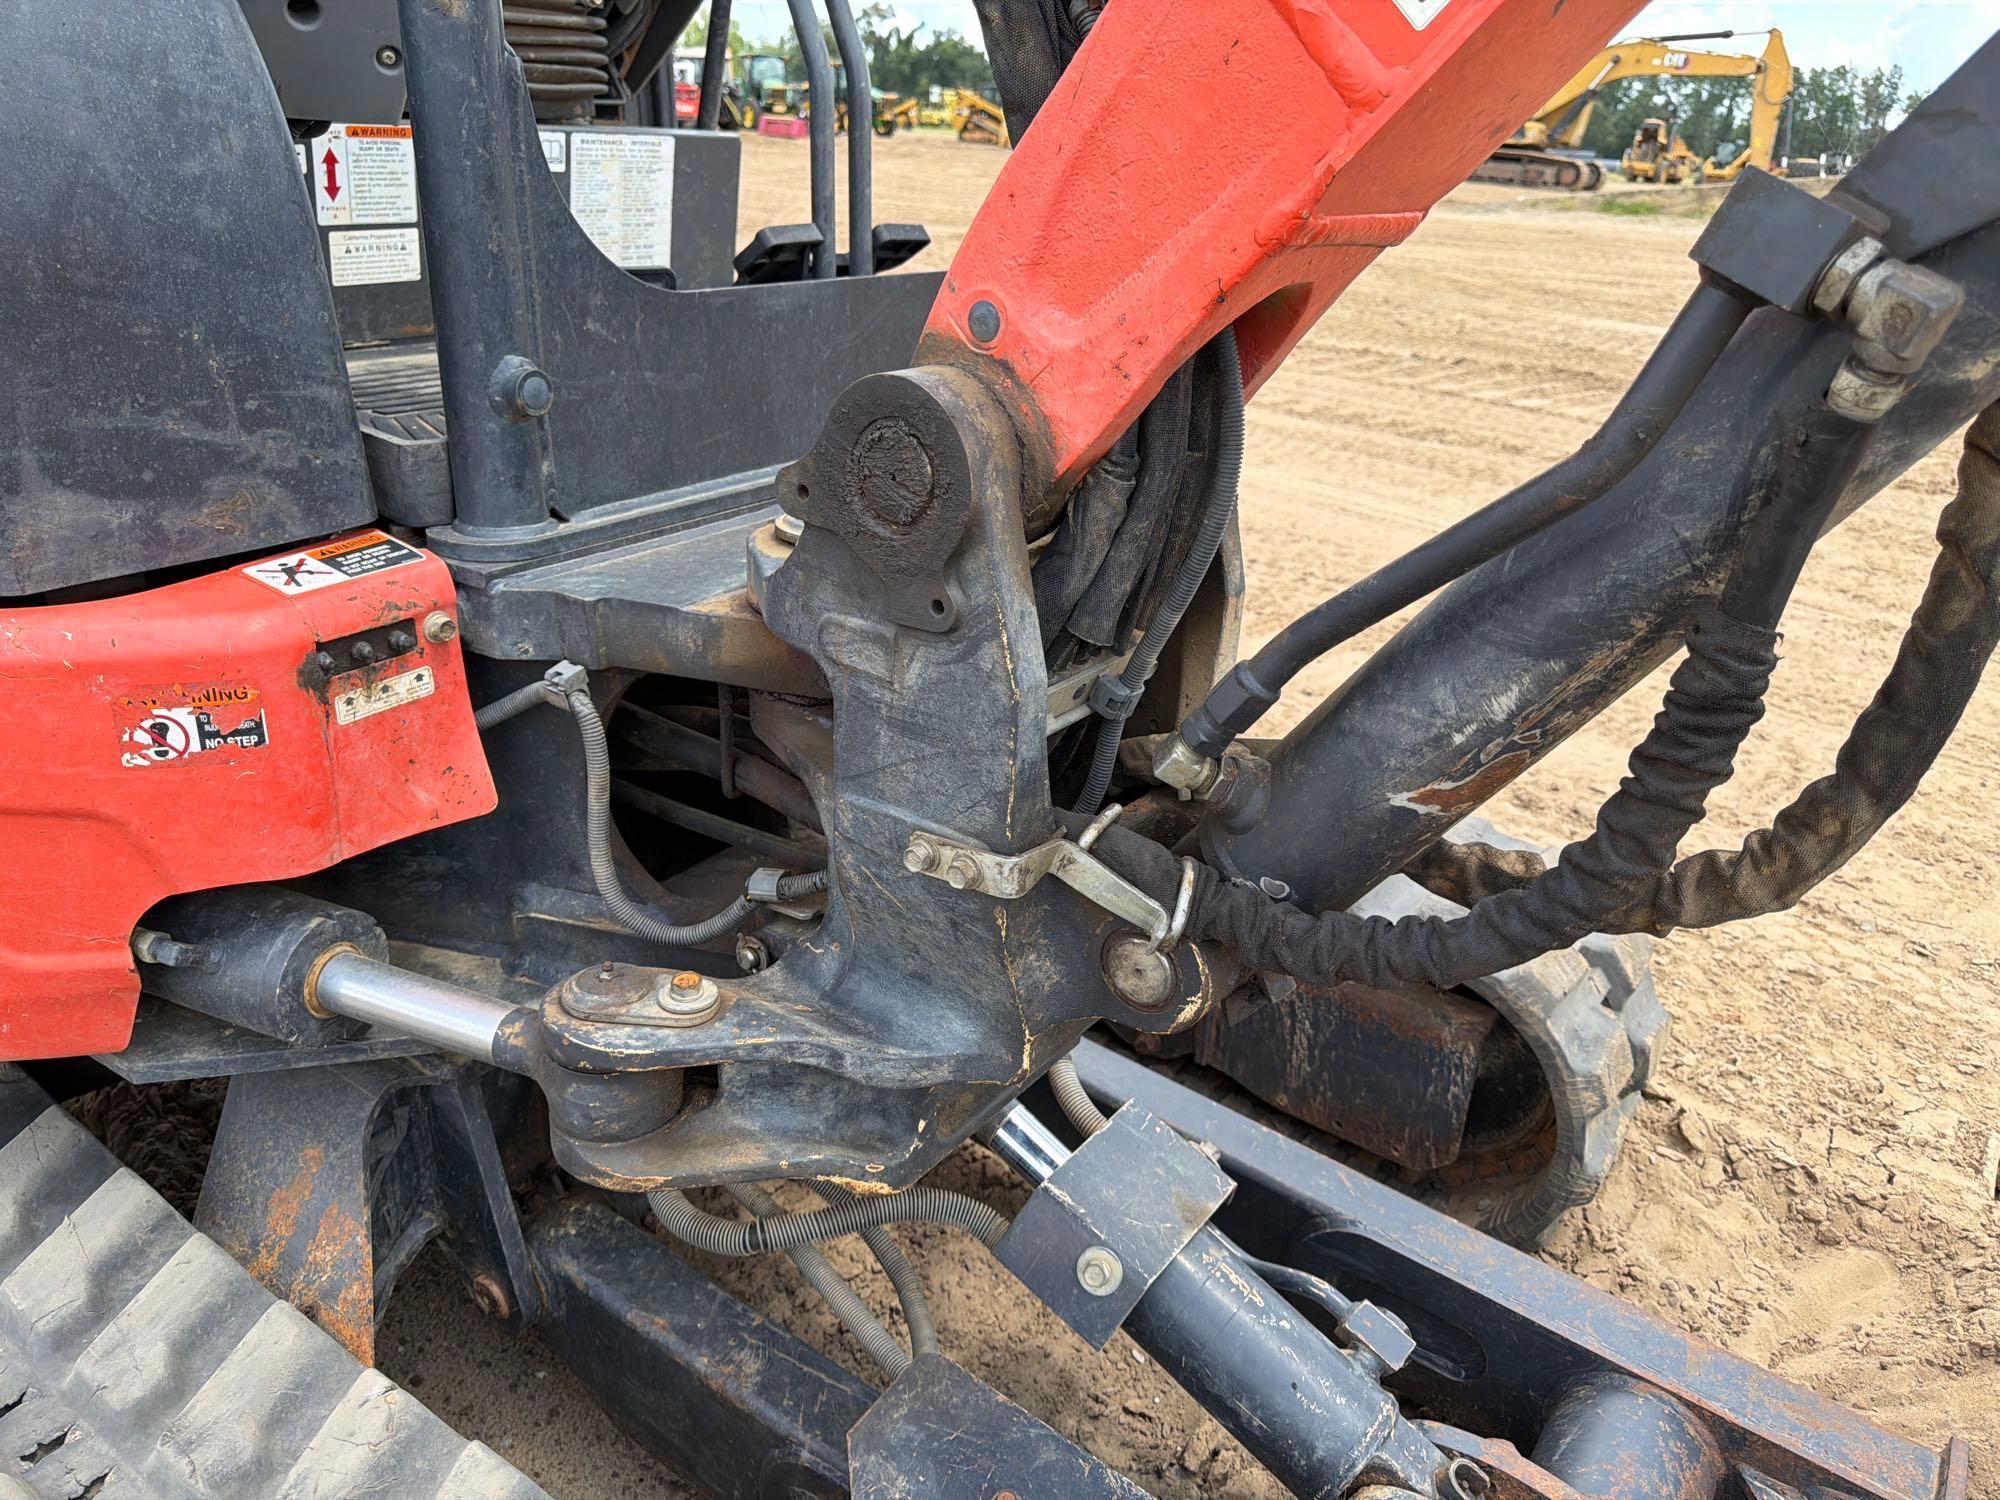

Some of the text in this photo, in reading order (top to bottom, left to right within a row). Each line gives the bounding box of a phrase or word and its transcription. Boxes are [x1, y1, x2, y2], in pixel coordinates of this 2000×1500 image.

[361, 127, 407, 138] WARNING
[354, 243, 399, 254] WARNING
[335, 536, 380, 553] WARNING
[199, 714, 208, 723] TO
[205, 735, 258, 749] NO STEP
